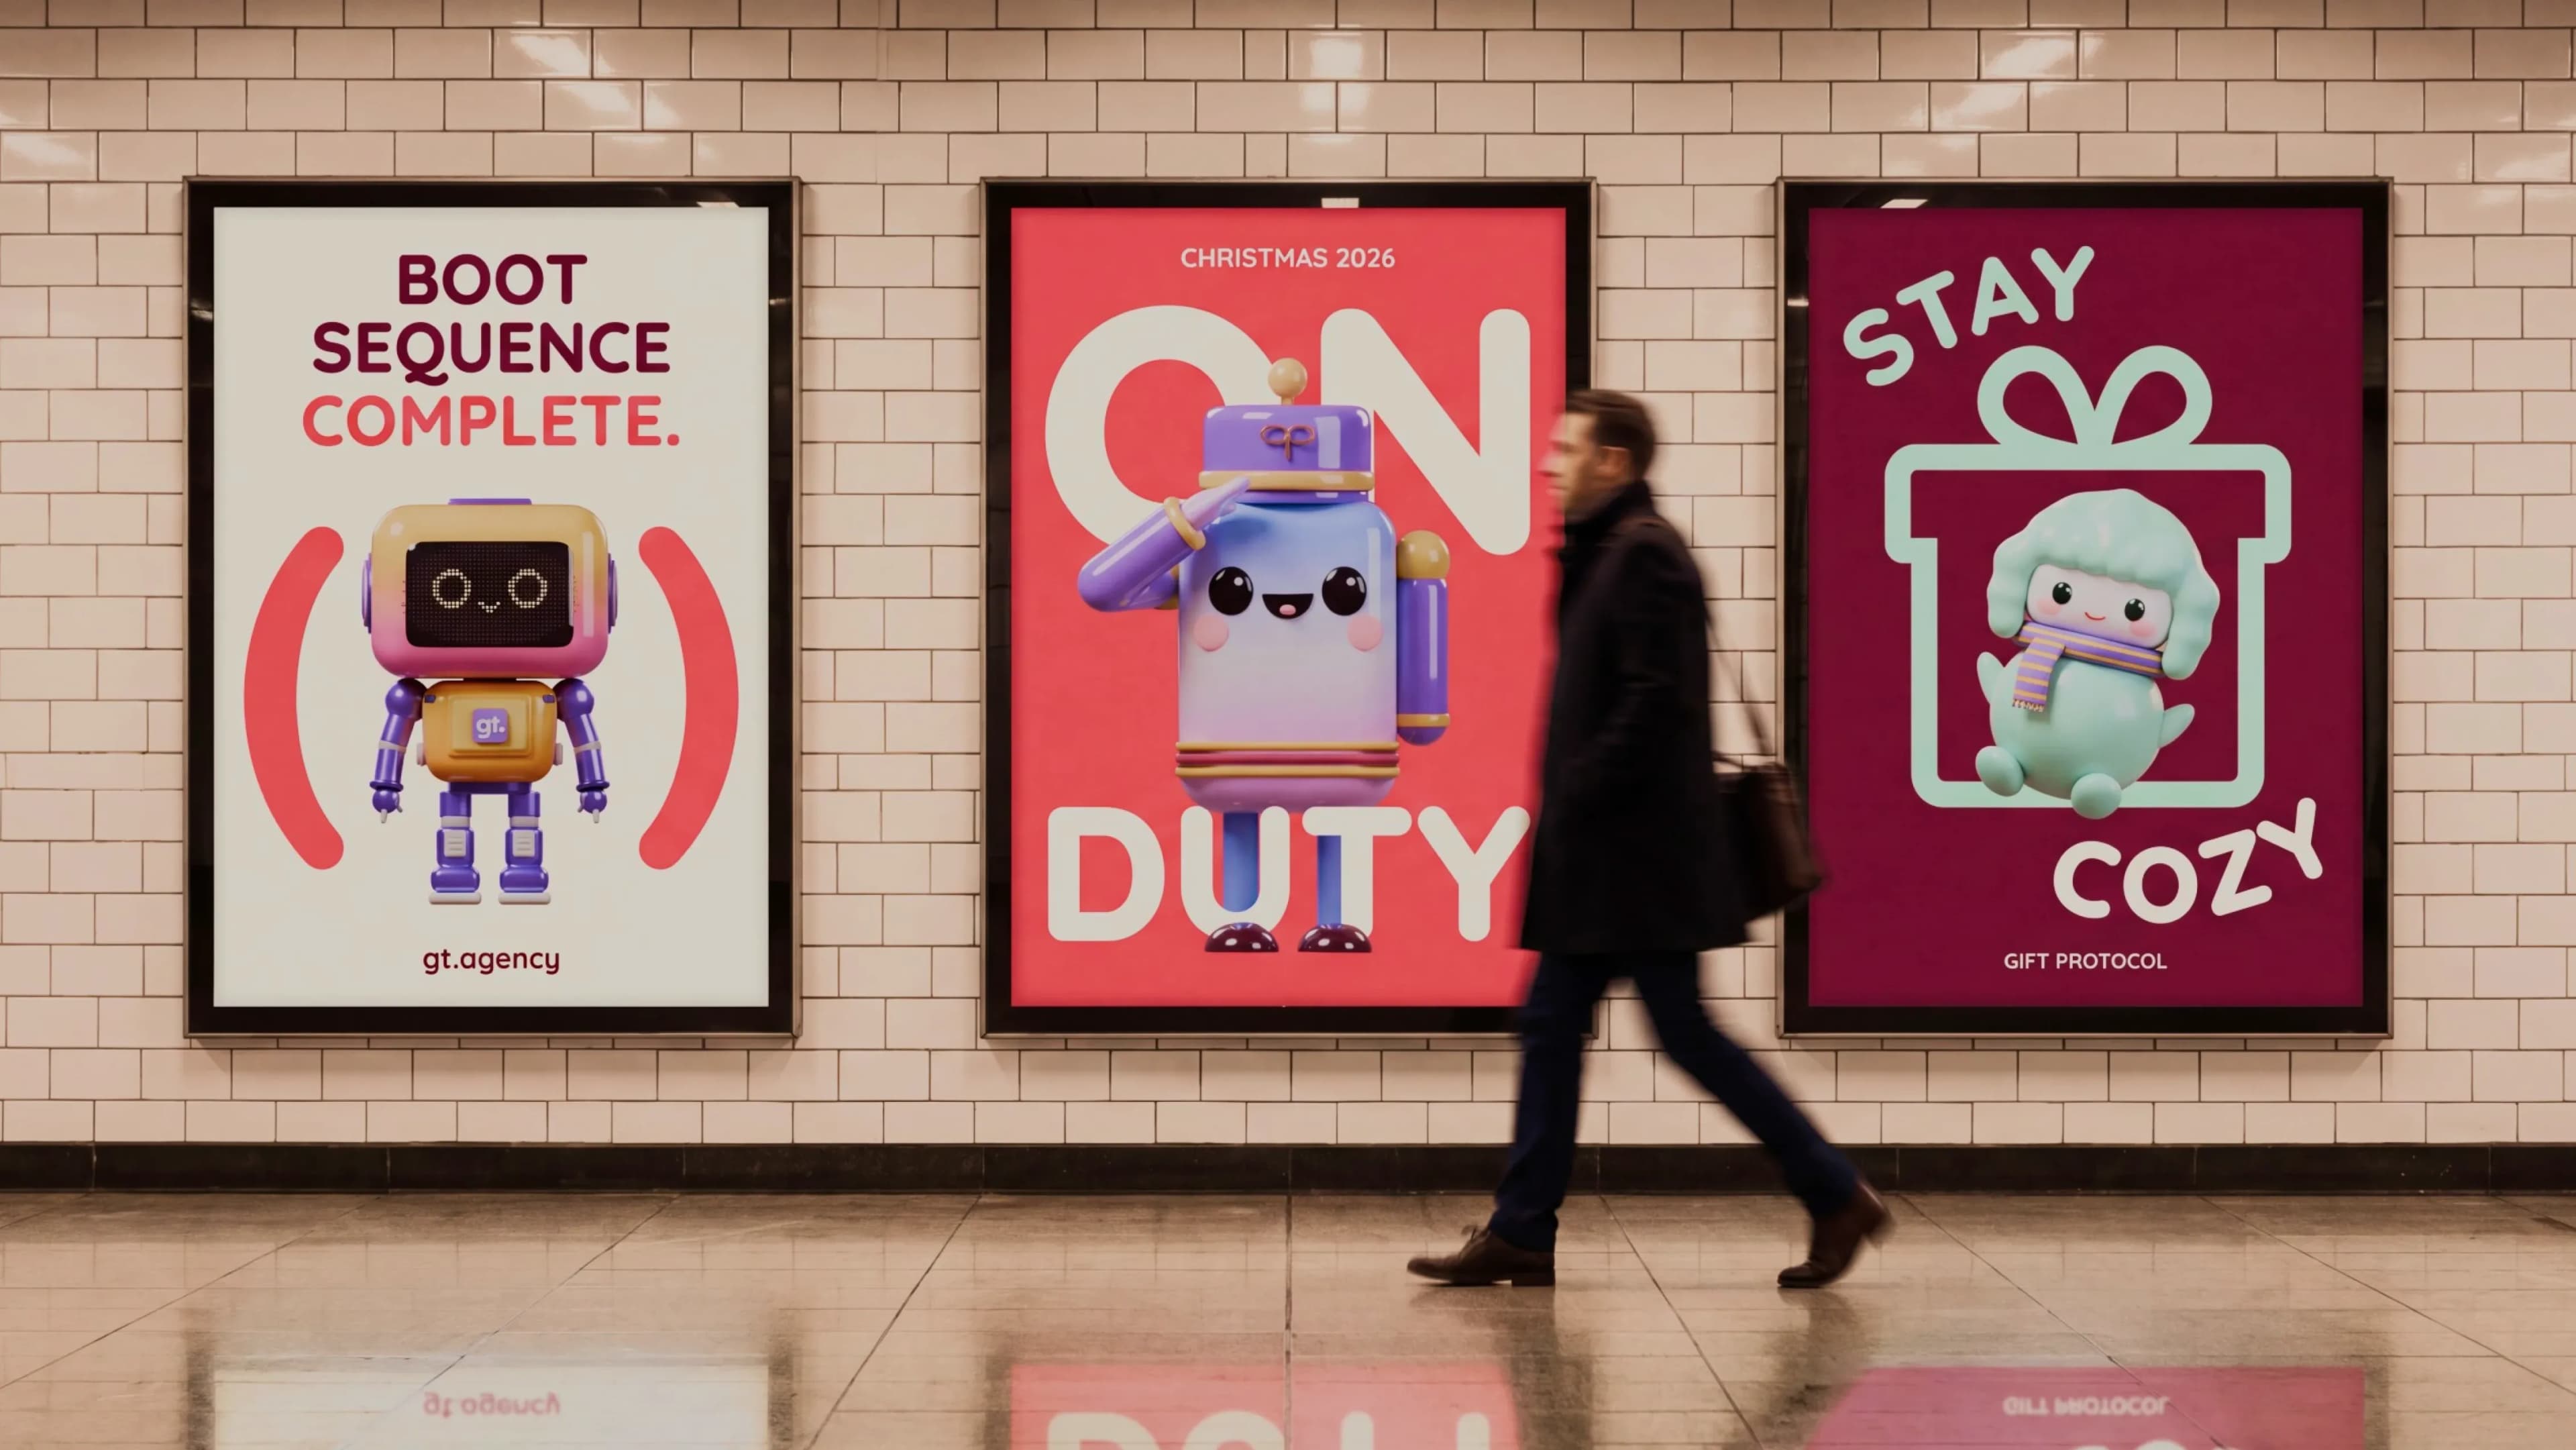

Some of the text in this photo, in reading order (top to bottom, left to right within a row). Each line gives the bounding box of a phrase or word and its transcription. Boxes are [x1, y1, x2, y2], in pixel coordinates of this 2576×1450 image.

[398, 253, 588, 306] BOOT
[1180, 247, 1396, 268] CHRISTMAS 2026
[1843, 246, 2095, 386] STAY
[313, 321, 671, 387] SEQUENCE
[303, 395, 680, 447] COMPLETE.
[1045, 305, 1531, 556] ON
[476, 715, 505, 739] gt.
[1048, 805, 1531, 941] DUTY
[2053, 797, 2323, 925] COZY
[423, 948, 560, 976] gt.agency
[2003, 952, 2168, 970] GIFT PROTOCOL
